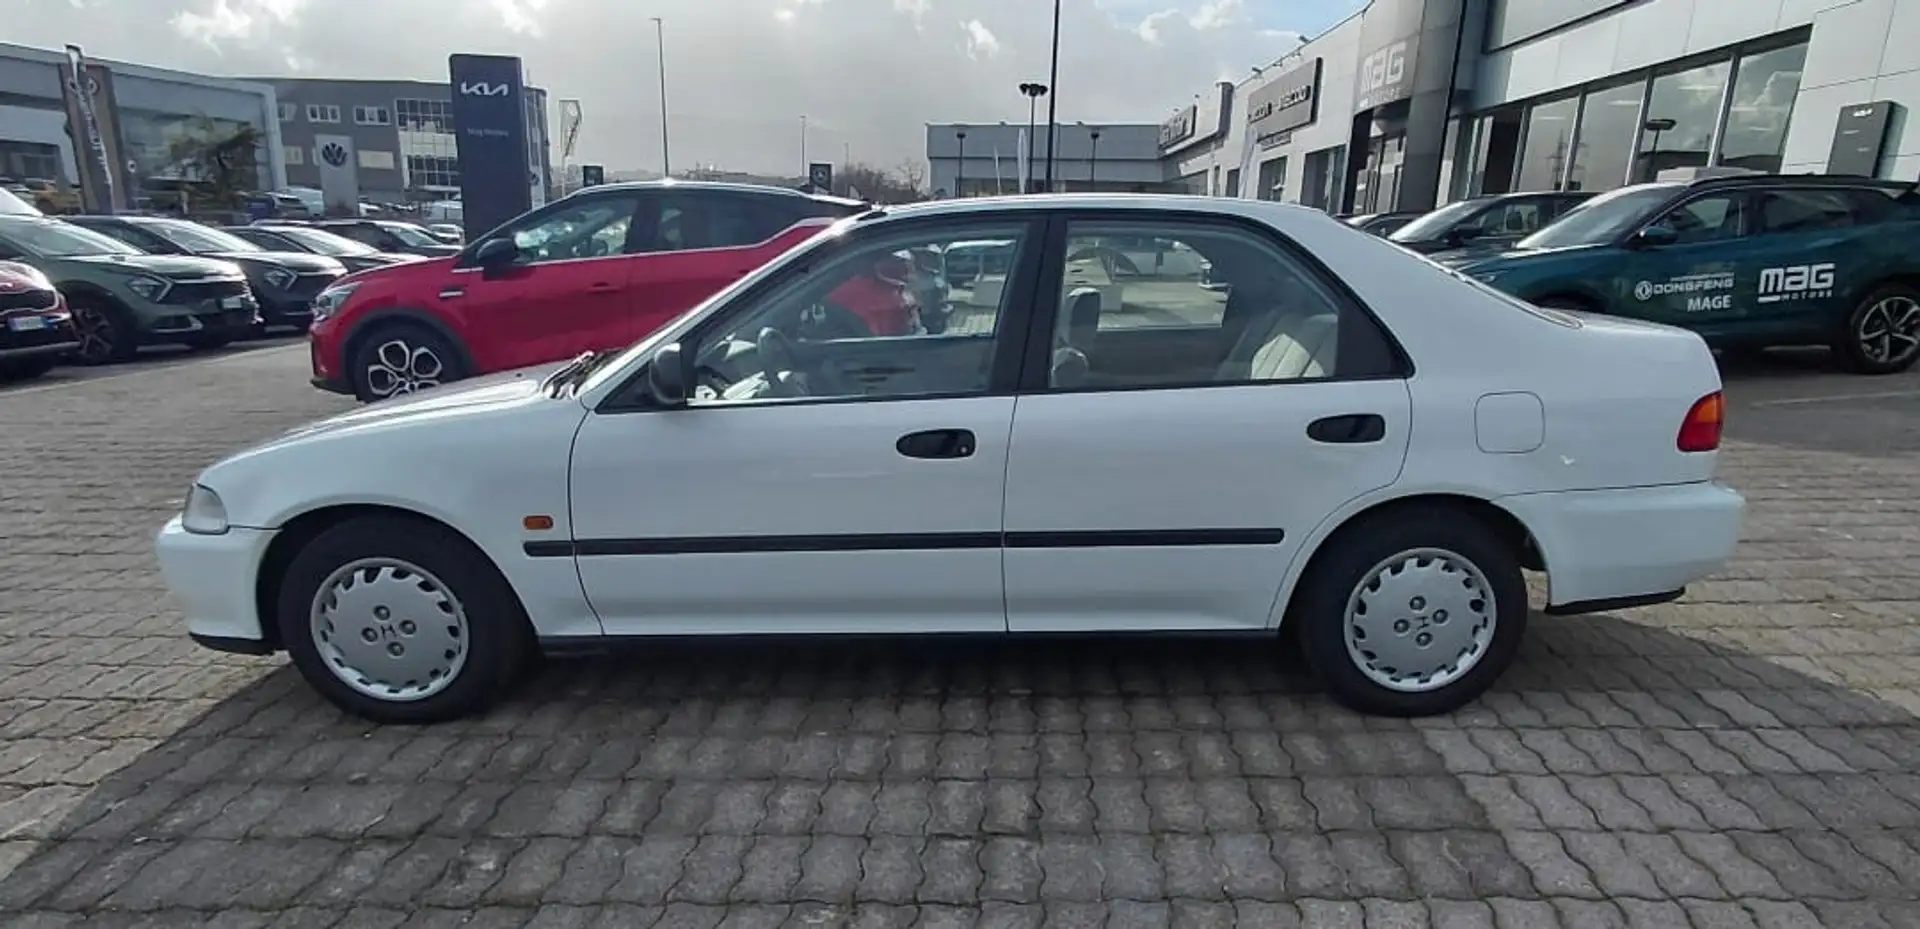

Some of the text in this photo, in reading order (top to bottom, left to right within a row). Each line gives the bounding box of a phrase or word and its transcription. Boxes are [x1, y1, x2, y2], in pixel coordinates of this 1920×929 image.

[460, 82, 509, 96] KIA
[1653, 278, 1734, 295] DONGFENG
[1687, 294, 1732, 312] MAGE
